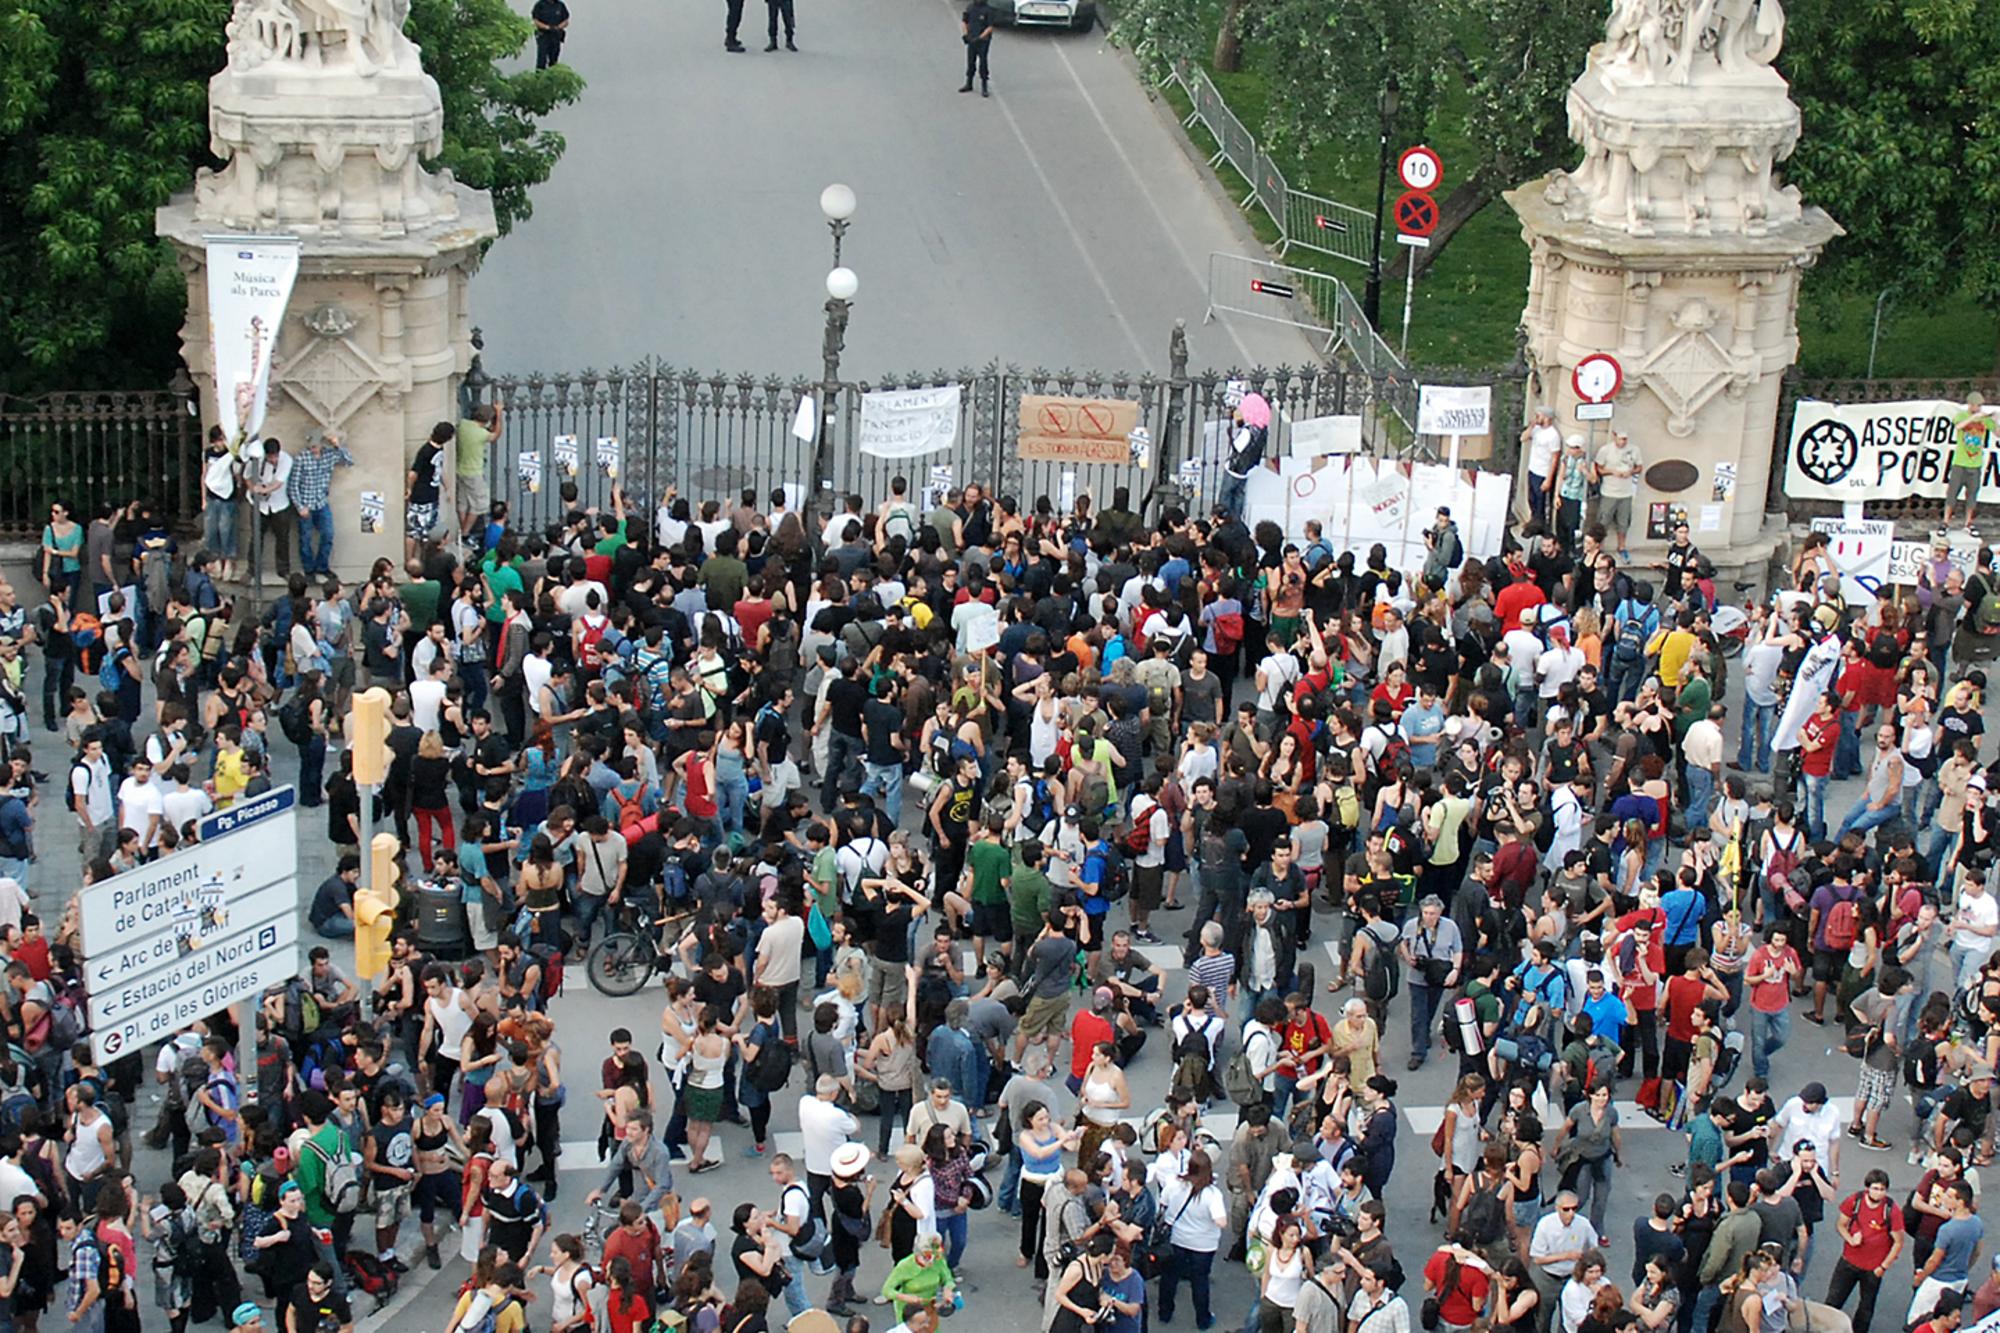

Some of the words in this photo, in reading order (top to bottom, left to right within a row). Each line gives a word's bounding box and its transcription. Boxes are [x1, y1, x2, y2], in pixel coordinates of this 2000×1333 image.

[1411, 162, 1428, 178] 10
[231, 284, 247, 296] als
[249, 286, 281, 297] Parcs
[233, 271, 276, 283] Música
[1861, 416, 1989, 448] ASSEMBL
[1876, 446, 2000, 487] POBLN
[217, 816, 236, 830] Pg.
[237, 798, 279, 823] Picasso
[113, 863, 200, 910] Parlament
[115, 913, 136, 933] de
[119, 949, 148, 972] Arc
[153, 939, 173, 957] de
[122, 968, 182, 1009] Estació
[186, 959, 211, 980] del
[215, 936, 253, 966] Nord
[124, 1022, 145, 1043] Pl.
[150, 1012, 170, 1032] de
[175, 1001, 198, 1021] les
[202, 970, 258, 1008] Glòries
